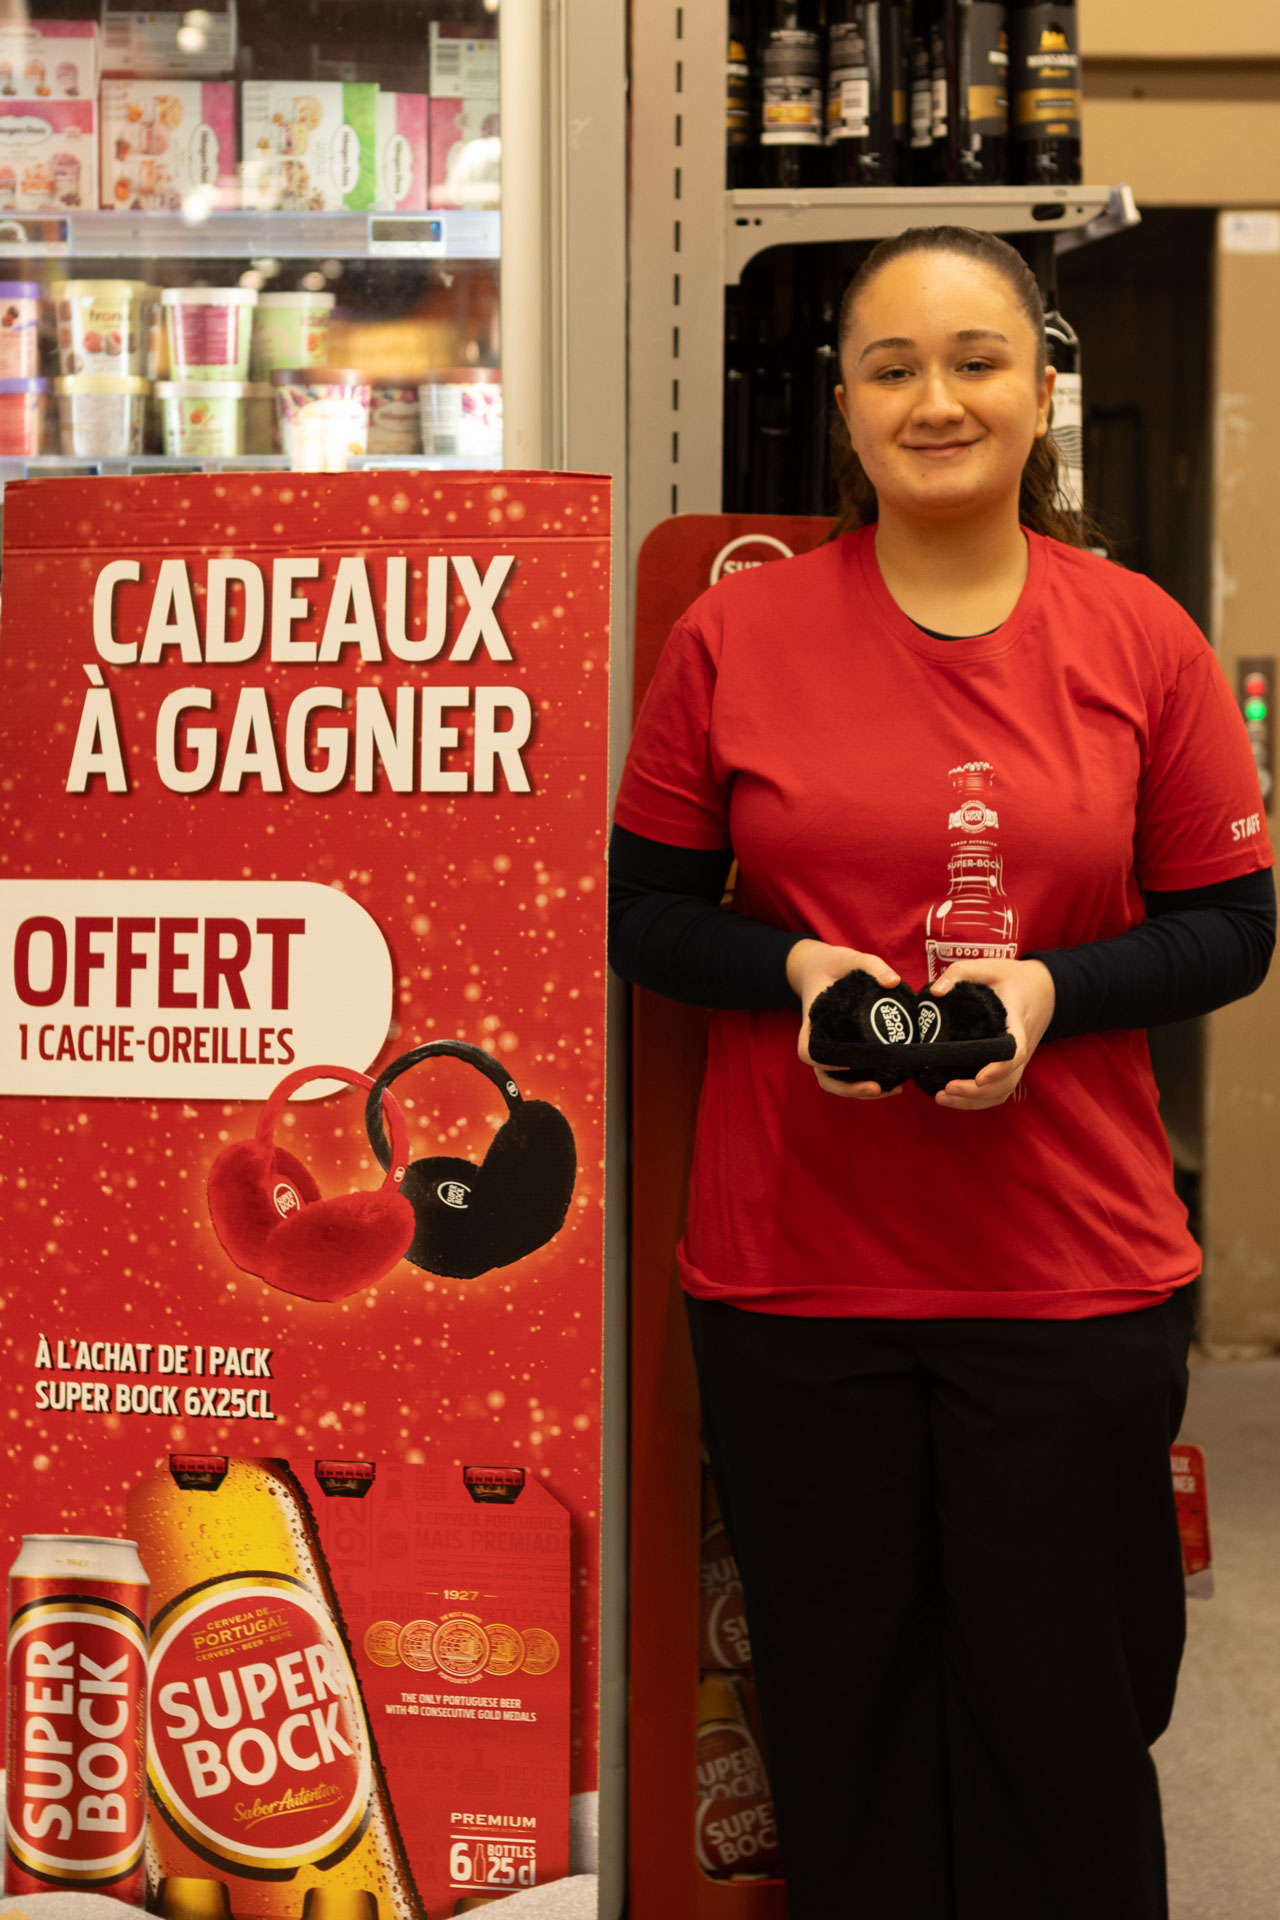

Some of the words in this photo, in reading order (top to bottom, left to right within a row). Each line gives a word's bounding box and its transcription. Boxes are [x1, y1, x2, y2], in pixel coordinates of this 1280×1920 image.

[92, 555, 515, 665] CADEAUX
[66, 664, 127, 793] À
[155, 686, 532, 793] GAGNER
[1231, 813, 1260, 842] STAFF
[947, 859, 1001, 870] SUPER-BOCK
[14, 916, 305, 1010] OFFERT
[880, 1005, 898, 1043] SUPER
[890, 1006, 906, 1040] BOCK
[19, 1024, 28, 1060] 1
[38, 1024, 295, 1065] CACHE-OREILLES
[34, 1332, 52, 1369] À
[57, 1338, 152, 1373] L'ACHAT
[158, 1344, 190, 1374] DE
[194, 1345, 203, 1375] 1
[209, 1346, 272, 1377] PACK
[35, 1380, 110, 1412] SUPER
[115, 1383, 179, 1415] BOCK
[184, 1386, 275, 1418] 6X25CL
[443, 1589, 480, 1601] 1927
[193, 1615, 288, 1649] PORTUGAL
[206, 1611, 254, 1631] CERVEJA
[255, 1607, 269, 1617] DE
[241, 1639, 264, 1651] BEER
[158, 1643, 343, 1740] SUPER
[401, 1692, 417, 1703] THE
[418, 1694, 443, 1705] ONLY
[443, 1695, 498, 1708] PORTUGUESE
[499, 1698, 522, 1709] BEER
[385, 1704, 407, 1715] WITH
[407, 1705, 419, 1715] 40
[420, 1706, 476, 1719] CONSECUTIVE
[477, 1709, 502, 1720] GOLD
[502, 1711, 537, 1722] MEDALS
[23, 1640, 75, 1840] SUPER
[77, 1653, 130, 1833] BOCK
[182, 1702, 355, 1799] BOCK
[697, 1747, 757, 1784] UPER
[232, 1797, 279, 1822] Sabor
[451, 1812, 537, 1828] PREMIUM
[705, 1802, 776, 1845] SUPE
[450, 1842, 472, 1881] 6
[487, 1844, 536, 1859] BOTTLES
[718, 1826, 778, 1865] BOC
[487, 1857, 514, 1885] 25
[518, 1860, 536, 1886] cl
